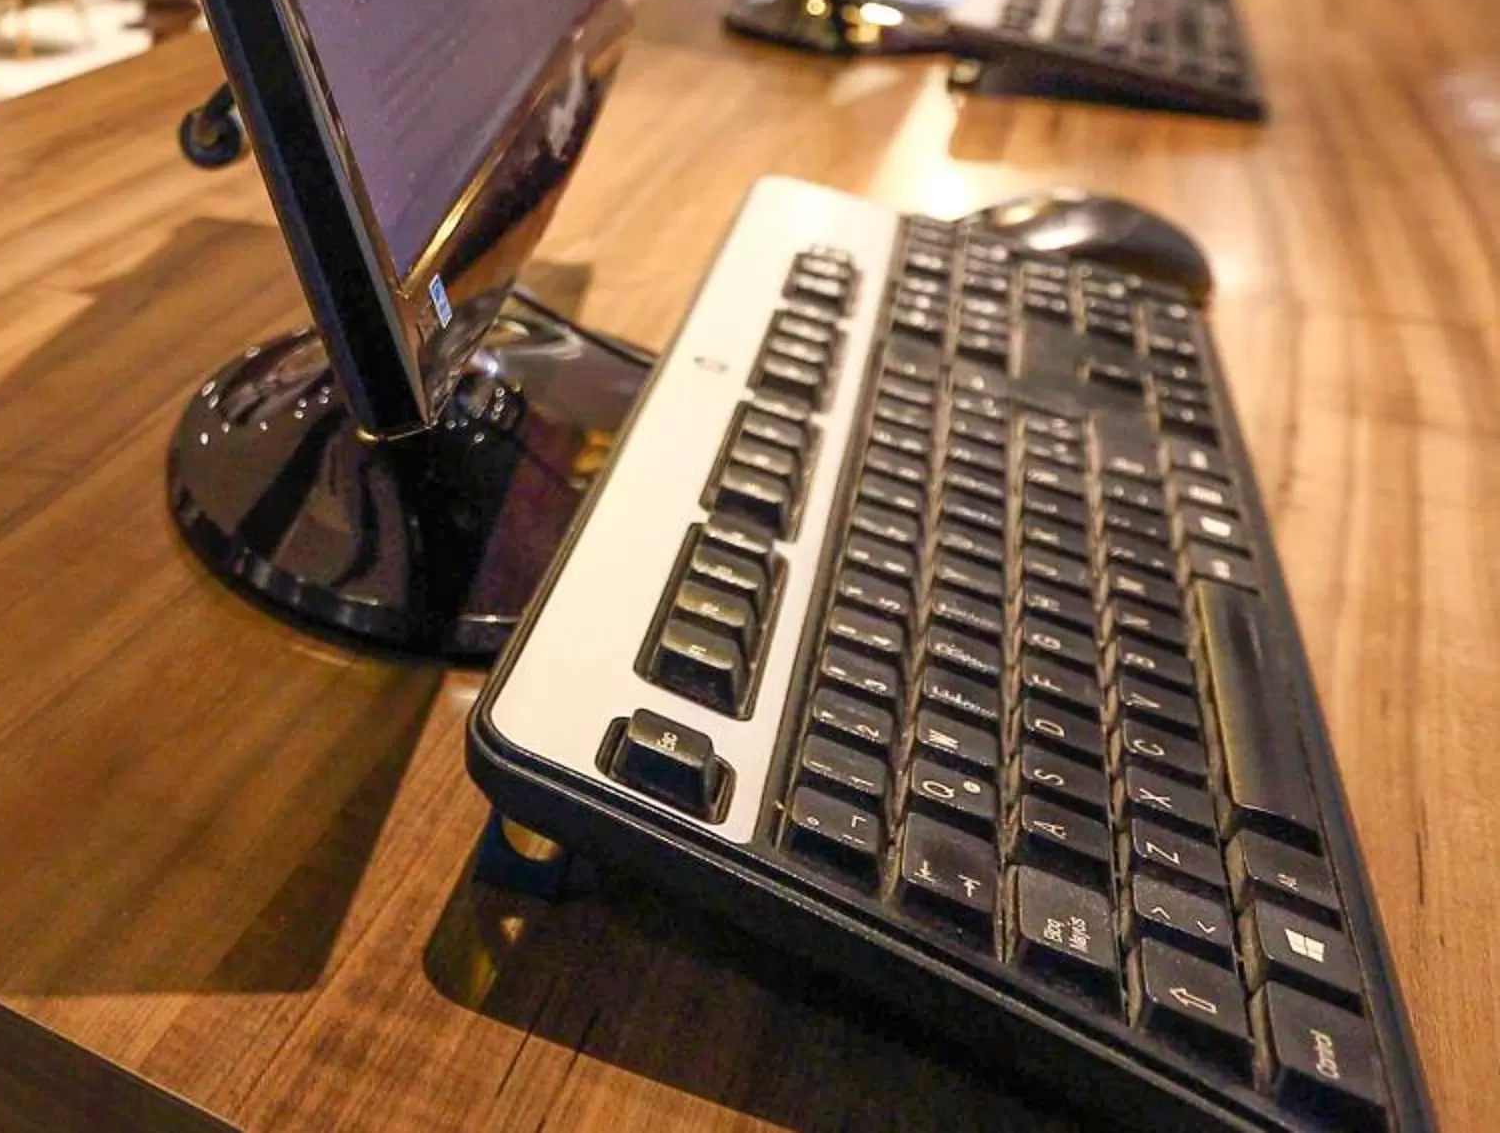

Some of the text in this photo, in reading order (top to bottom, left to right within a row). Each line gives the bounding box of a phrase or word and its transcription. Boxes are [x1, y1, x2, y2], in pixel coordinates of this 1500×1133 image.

[1030, 673, 1063, 692] F
[1126, 692, 1162, 709] V
[856, 724, 880, 741] 2
[1033, 718, 1066, 739] D
[928, 728, 961, 750] W
[1132, 739, 1166, 756] C
[1033, 768, 1066, 786] S
[922, 779, 956, 798] Q
[1139, 787, 1173, 808] X
[1032, 818, 1067, 841] A
[1145, 841, 1180, 865] Z
[1308, 1027, 1342, 1081] Control
